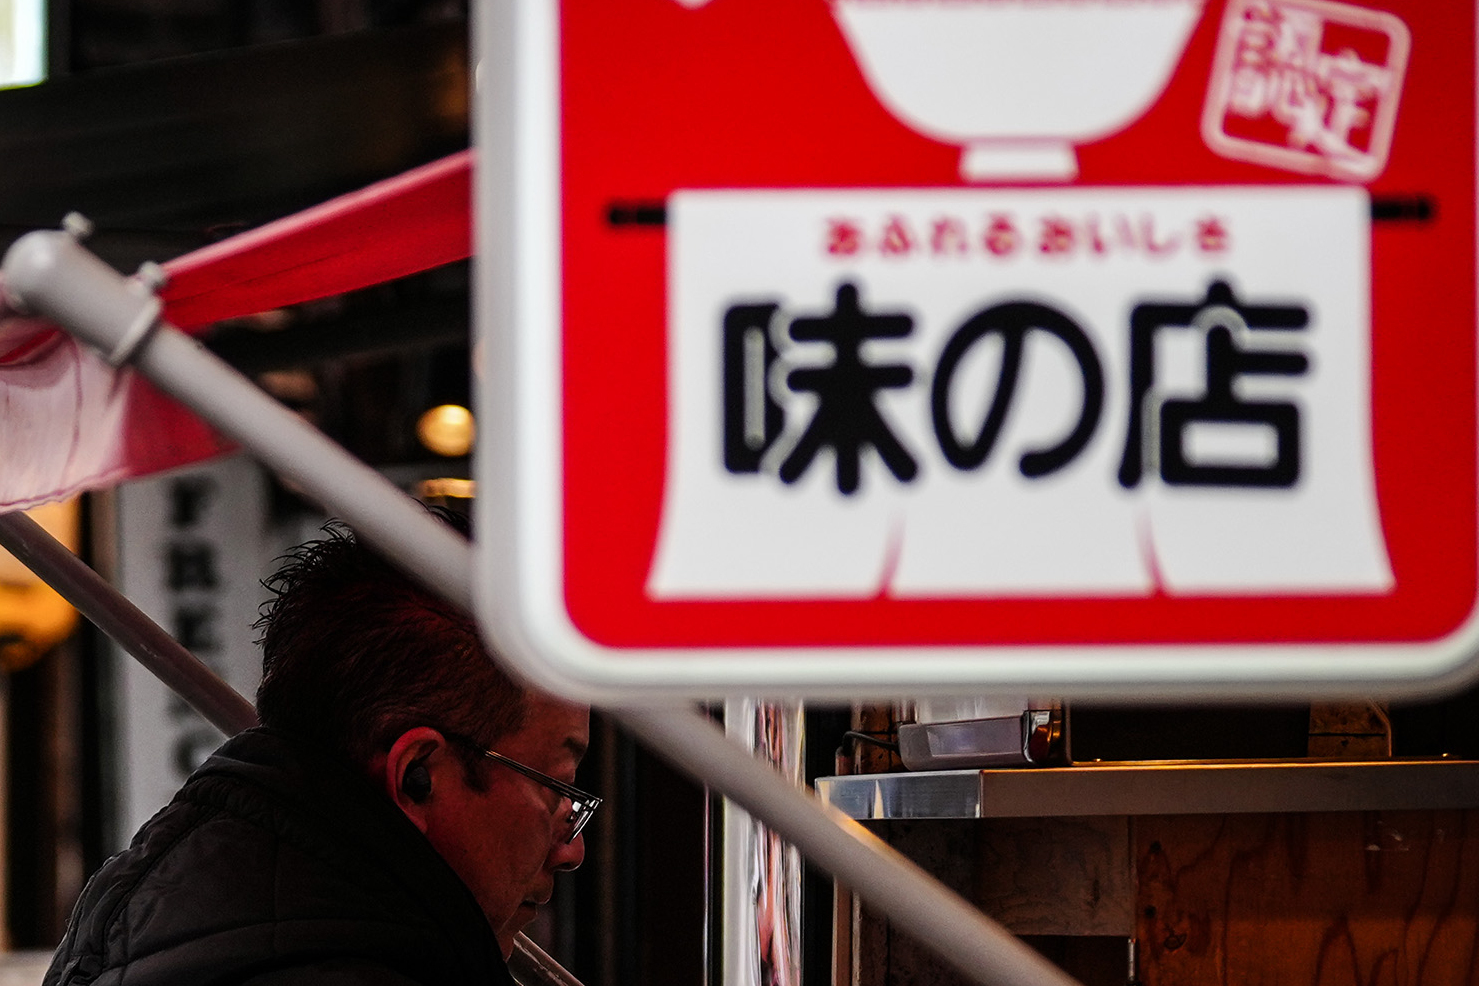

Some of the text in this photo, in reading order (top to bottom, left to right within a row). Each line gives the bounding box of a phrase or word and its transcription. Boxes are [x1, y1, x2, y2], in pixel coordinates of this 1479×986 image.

[822, 212, 1231, 258] あふれるおいしさ
[722, 280, 1311, 495] 味の店
